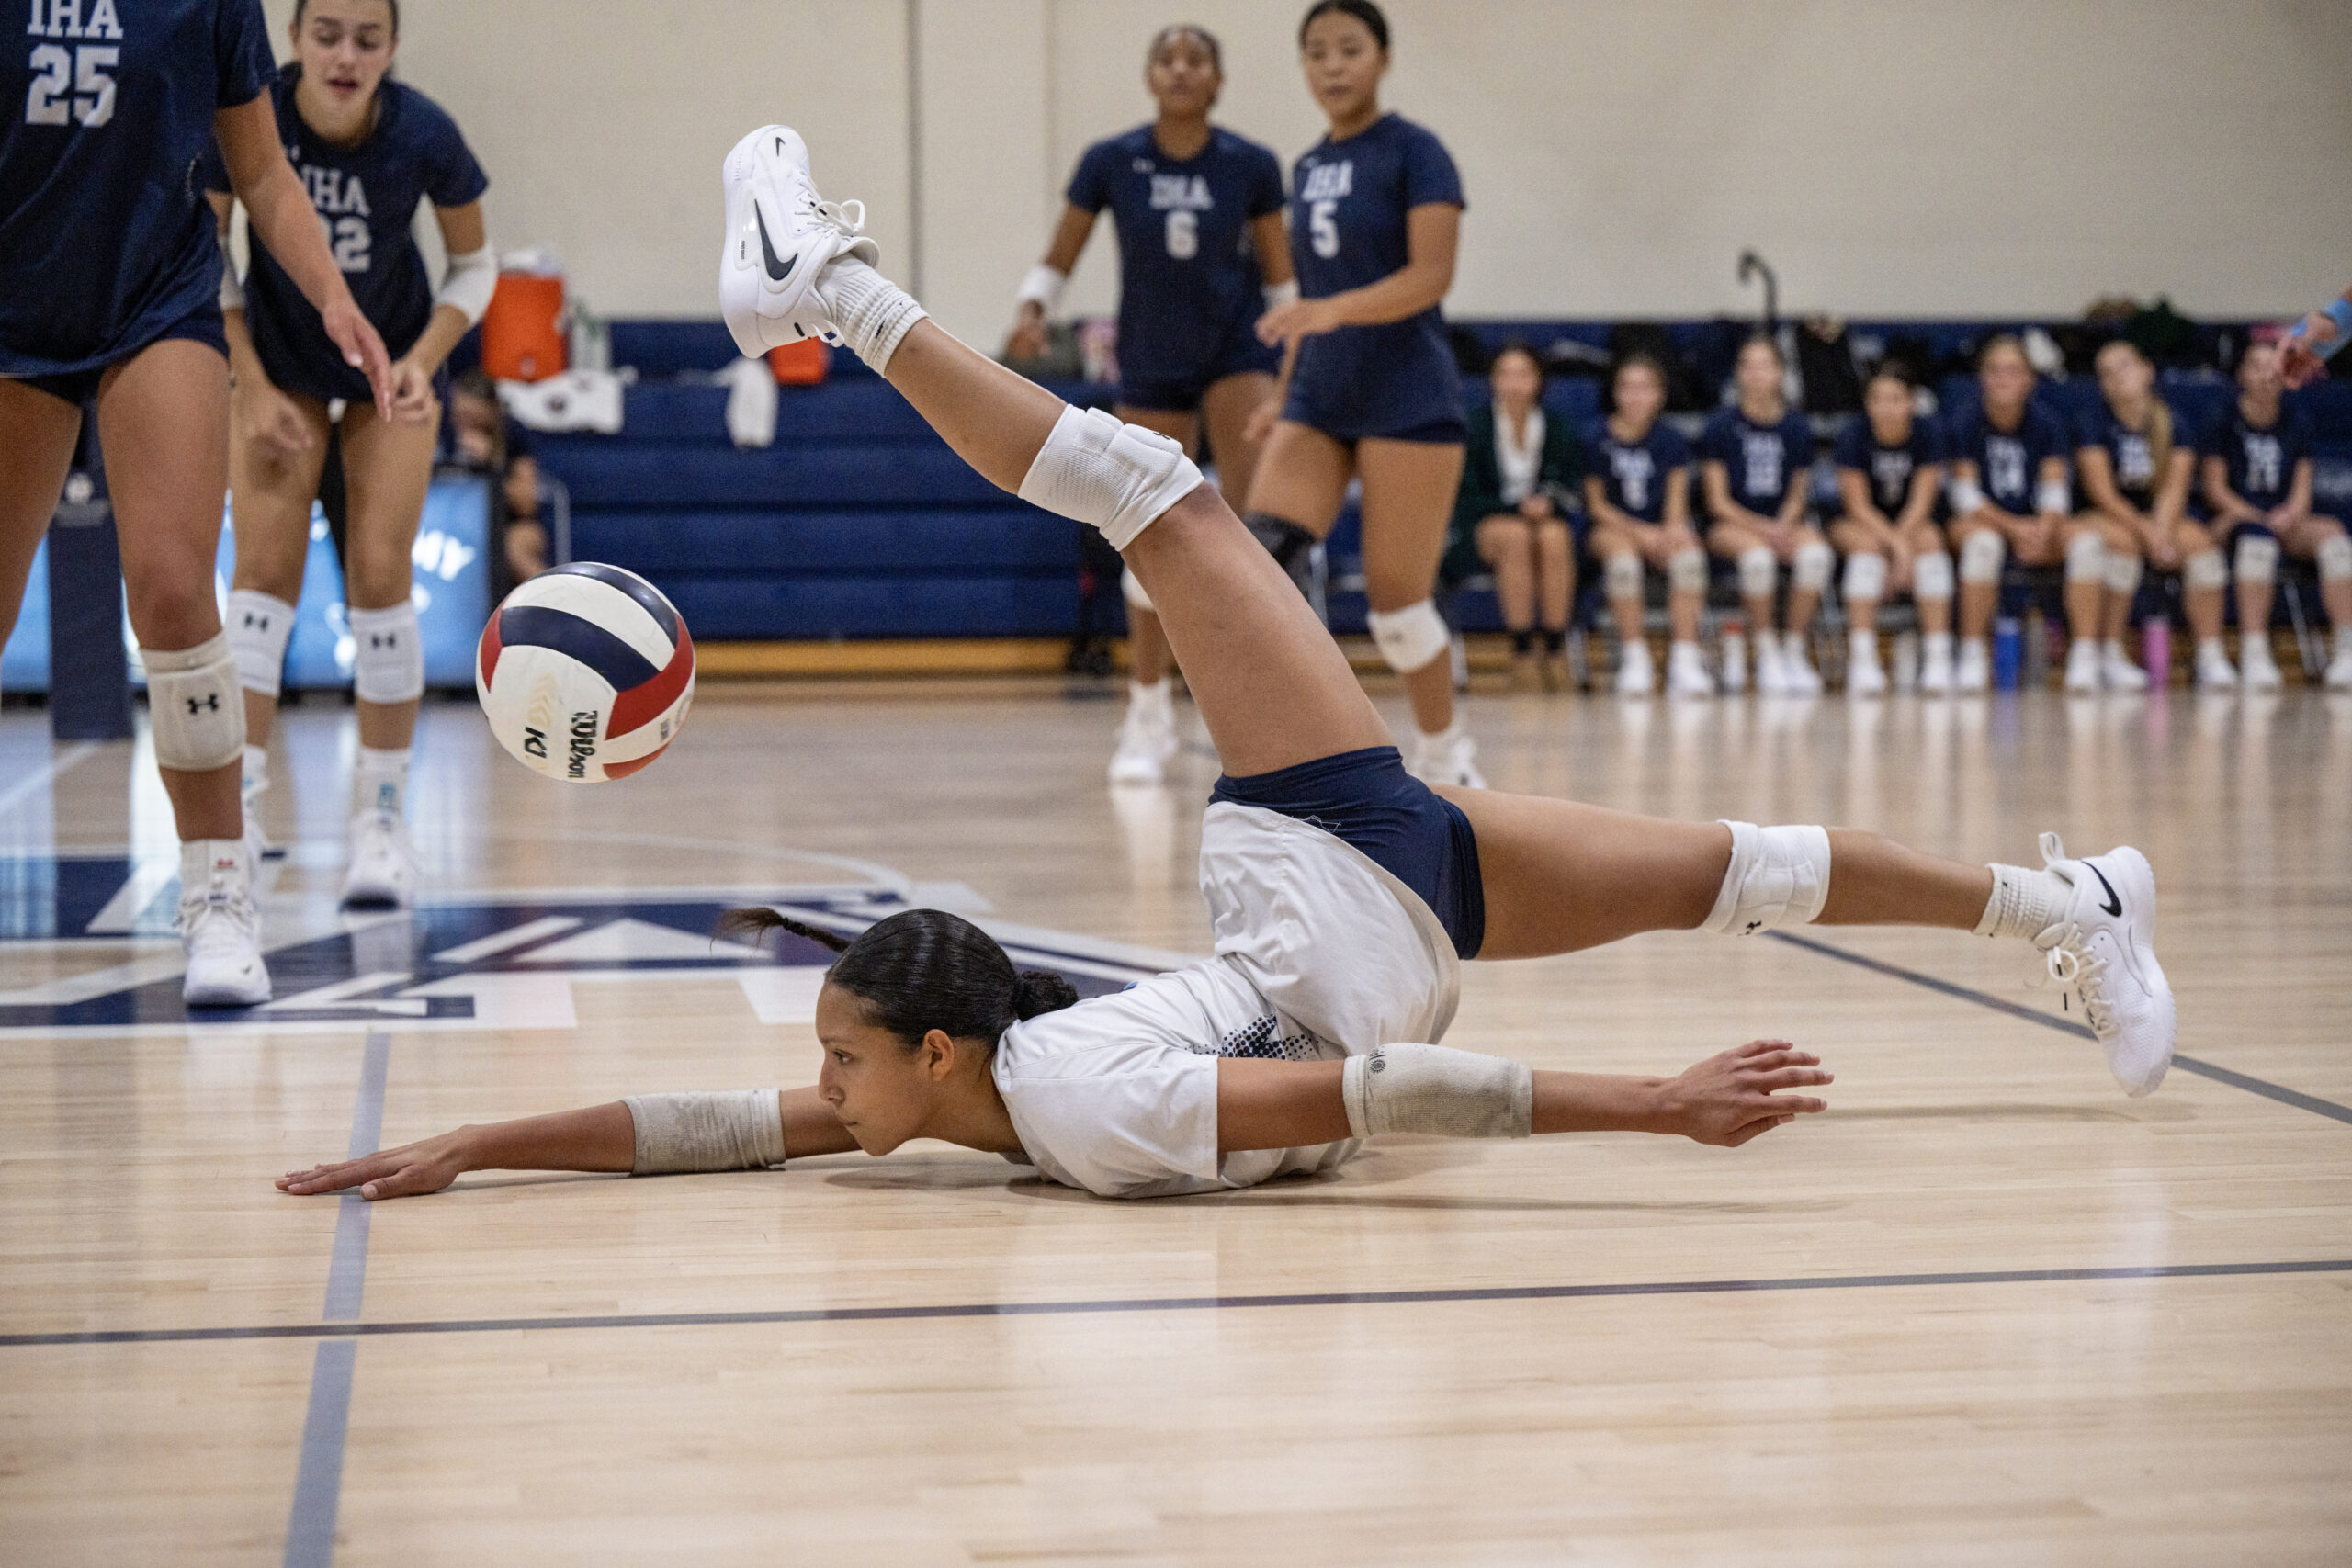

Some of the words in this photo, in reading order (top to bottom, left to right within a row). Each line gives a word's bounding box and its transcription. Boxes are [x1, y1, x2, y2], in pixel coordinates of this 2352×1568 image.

[27, 0, 124, 39] IHA
[25, 43, 120, 128] 25
[318, 214, 371, 272] 2
[1164, 210, 1199, 260] 6
[1309, 199, 1340, 260] 5
